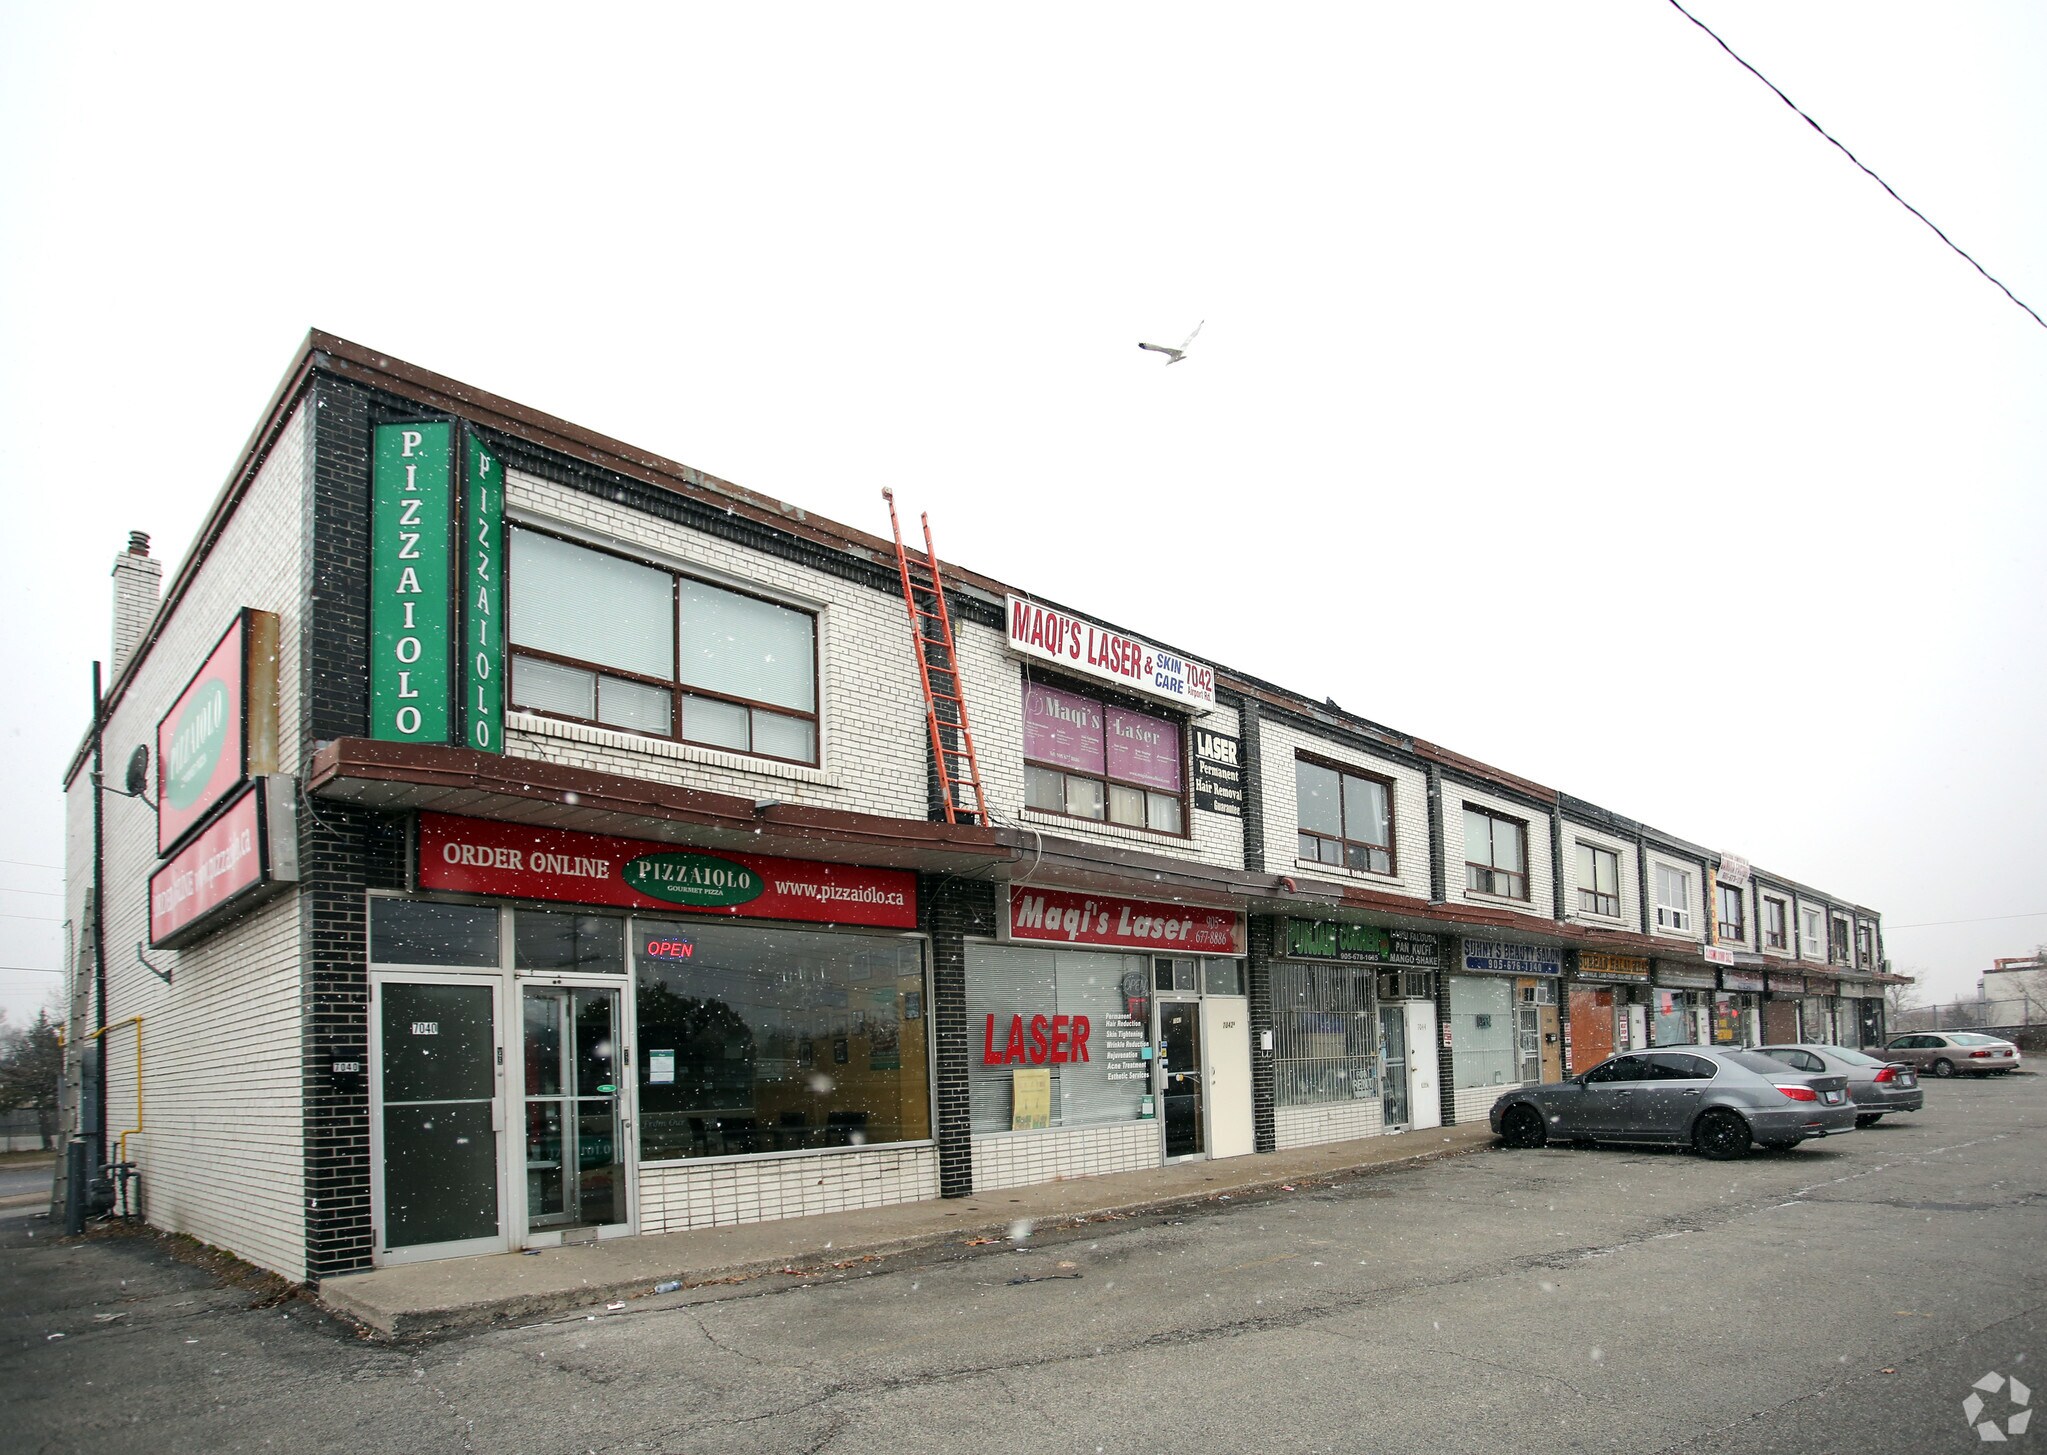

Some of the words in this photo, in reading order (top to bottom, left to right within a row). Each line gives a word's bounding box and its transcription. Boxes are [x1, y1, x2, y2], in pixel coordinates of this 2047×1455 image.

[395, 431, 423, 734] PIZZAIOLO
[476, 452, 490, 747] PIZZAIOLO
[1012, 601, 1081, 659] MAQI'S
[1088, 628, 1141, 680] LASER
[1144, 656, 1153, 675] &
[1156, 653, 1182, 674] SKIN
[1155, 672, 1184, 694] CARE
[1185, 663, 1212, 692] 7042
[1045, 697, 1100, 729] Maqi's
[1115, 719, 1160, 745] Laser
[1196, 731, 1238, 765] LASER
[1199, 760, 1239, 782] Permanent
[1196, 778, 1213, 793] Hair
[1213, 782, 1243, 801] Removal
[443, 842, 523, 870] ORDER
[530, 852, 609, 879] ONLINE
[637, 860, 750, 889] PIZZAIOLO
[775, 880, 904, 906] www.pizzaiolo.ca
[667, 885, 703, 896] GOURMET
[704, 888, 724, 896] PIZZA
[1017, 895, 1109, 940] Maqi's
[1117, 907, 1193, 940] Laser
[1206, 916, 1219, 929] 905
[1195, 930, 1227, 945] 677-8886
[1396, 942, 1410, 951] PAN
[648, 941, 693, 957] OPEN
[1390, 953, 1415, 964] MANGO
[1416, 955, 1438, 965] SHAKE
[1464, 939, 1501, 958] SUNNY'S
[1504, 943, 1535, 960] BEAUTY
[1536, 947, 1560, 963] SALON
[1488, 958, 1542, 971] 905-676-1140
[413, 1023, 437, 1034] 7040
[1106, 1030, 1117, 1038] Skin
[1118, 1030, 1143, 1039] Tightening
[984, 1014, 1091, 1065] LASER
[1106, 1041, 1125, 1049] Wrinkle
[1106, 1051, 1138, 1060] Rejuvenation
[1107, 1062, 1122, 1070] Acne
[334, 1062, 359, 1071] 7040
[1129, 1072, 1149, 1080] Services
